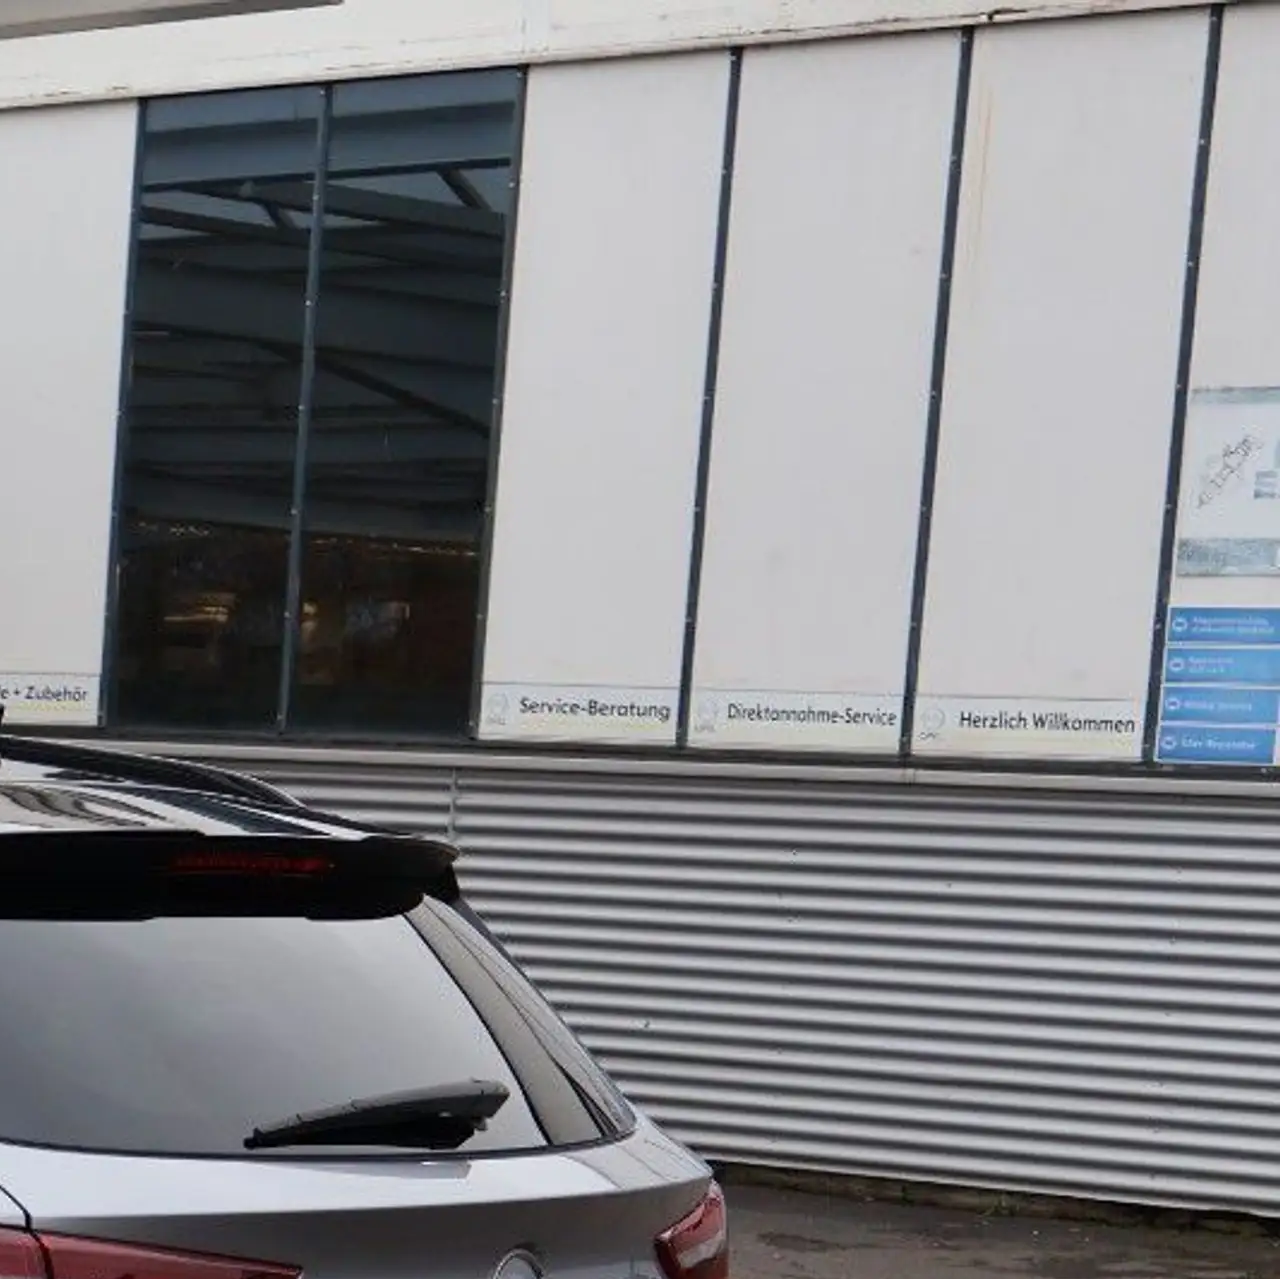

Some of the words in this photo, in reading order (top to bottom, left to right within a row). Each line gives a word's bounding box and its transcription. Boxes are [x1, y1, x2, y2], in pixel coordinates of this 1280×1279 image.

[25, 684, 88, 701] Zubehör
[519, 697, 671, 722] Service-Beratung
[727, 703, 897, 725] Direktannahme-Service
[959, 710, 1028, 730] Herzlich
[1032, 712, 1136, 733] Willkommen
